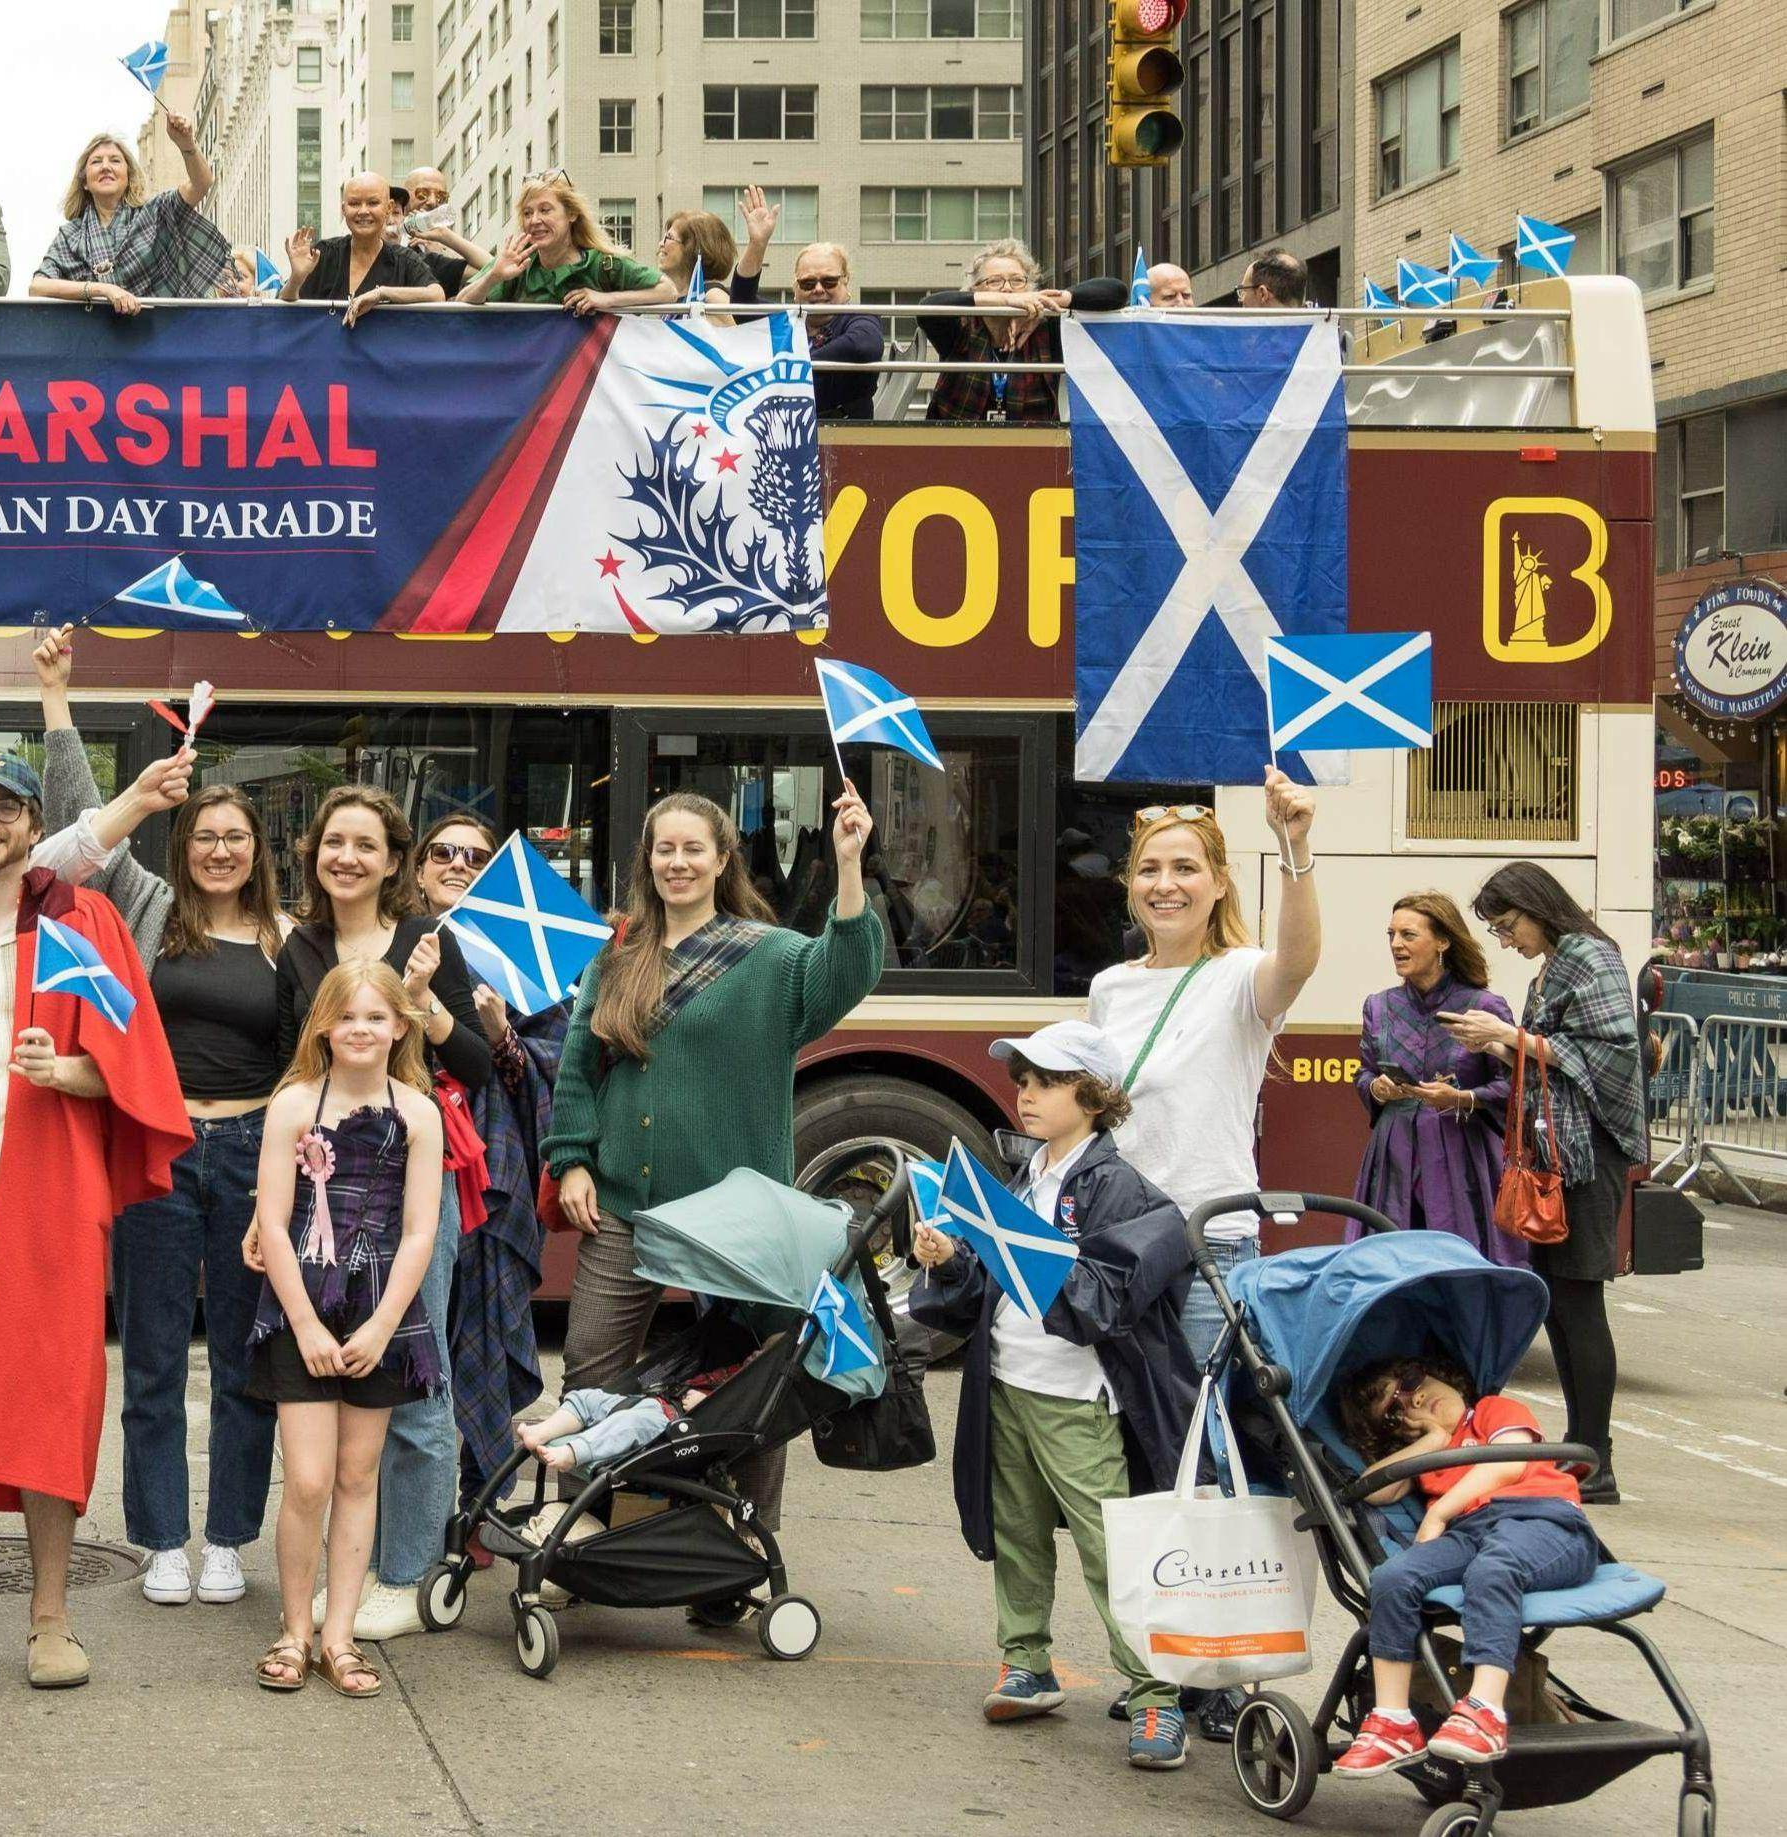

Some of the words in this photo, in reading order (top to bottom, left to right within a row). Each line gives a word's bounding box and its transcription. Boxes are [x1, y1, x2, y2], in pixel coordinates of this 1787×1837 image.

[66, 496, 167, 535] DAY
[179, 500, 376, 538] PARADE
[1705, 591, 1729, 611] FINE
[1736, 587, 1771, 606] FOODS
[1711, 614, 1742, 631] Ernest
[1707, 630, 1772, 669] Klein
[1686, 678, 1725, 712] GOURMET
[1728, 673, 1787, 713] MARKETPLAC
[1653, 770, 1686, 788] DS
[1728, 991, 1756, 1007] POLICE
[1763, 993, 1781, 1010] LINE
[1153, 1549, 1284, 1588] Citarella
